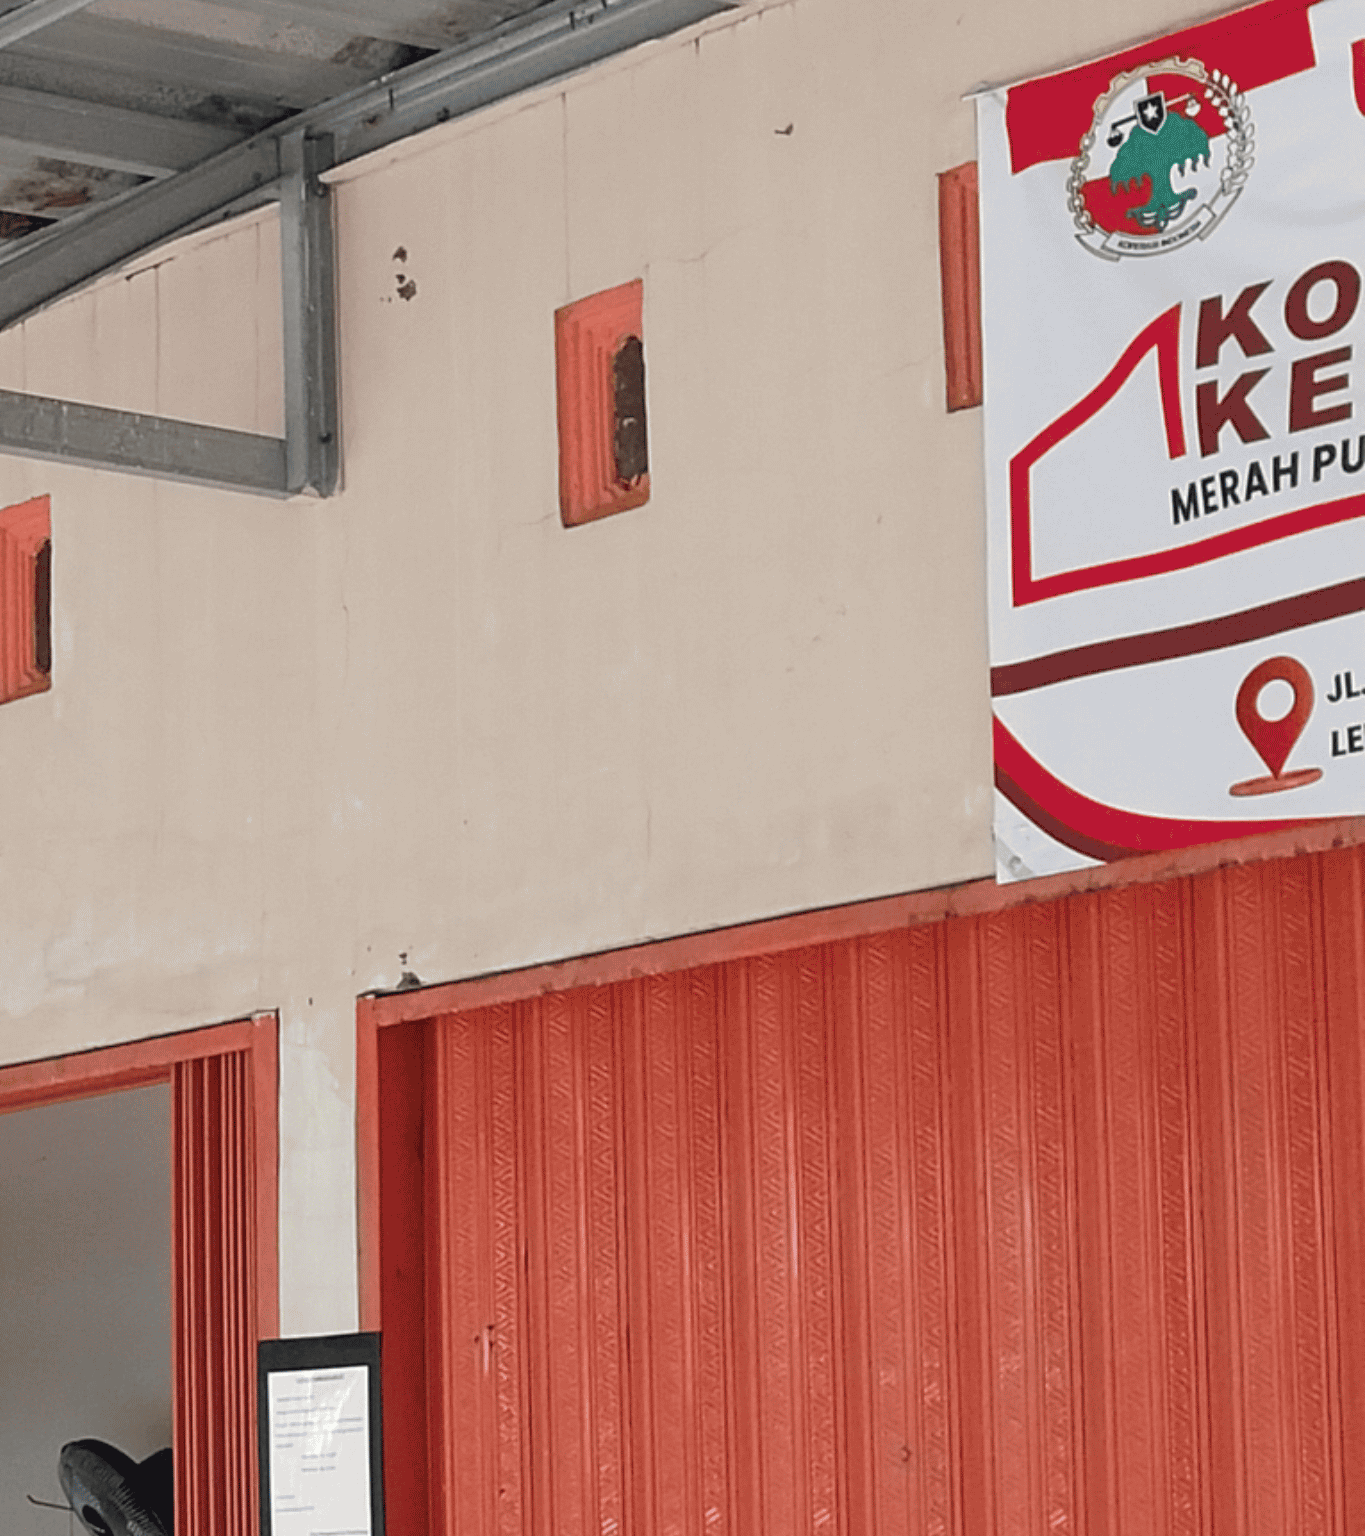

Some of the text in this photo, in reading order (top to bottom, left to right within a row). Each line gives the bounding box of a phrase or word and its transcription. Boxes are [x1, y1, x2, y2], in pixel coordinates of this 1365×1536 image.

[1195, 259, 1361, 370] KO
[1195, 344, 1354, 458] KE
[1171, 450, 1299, 525] MERAH
